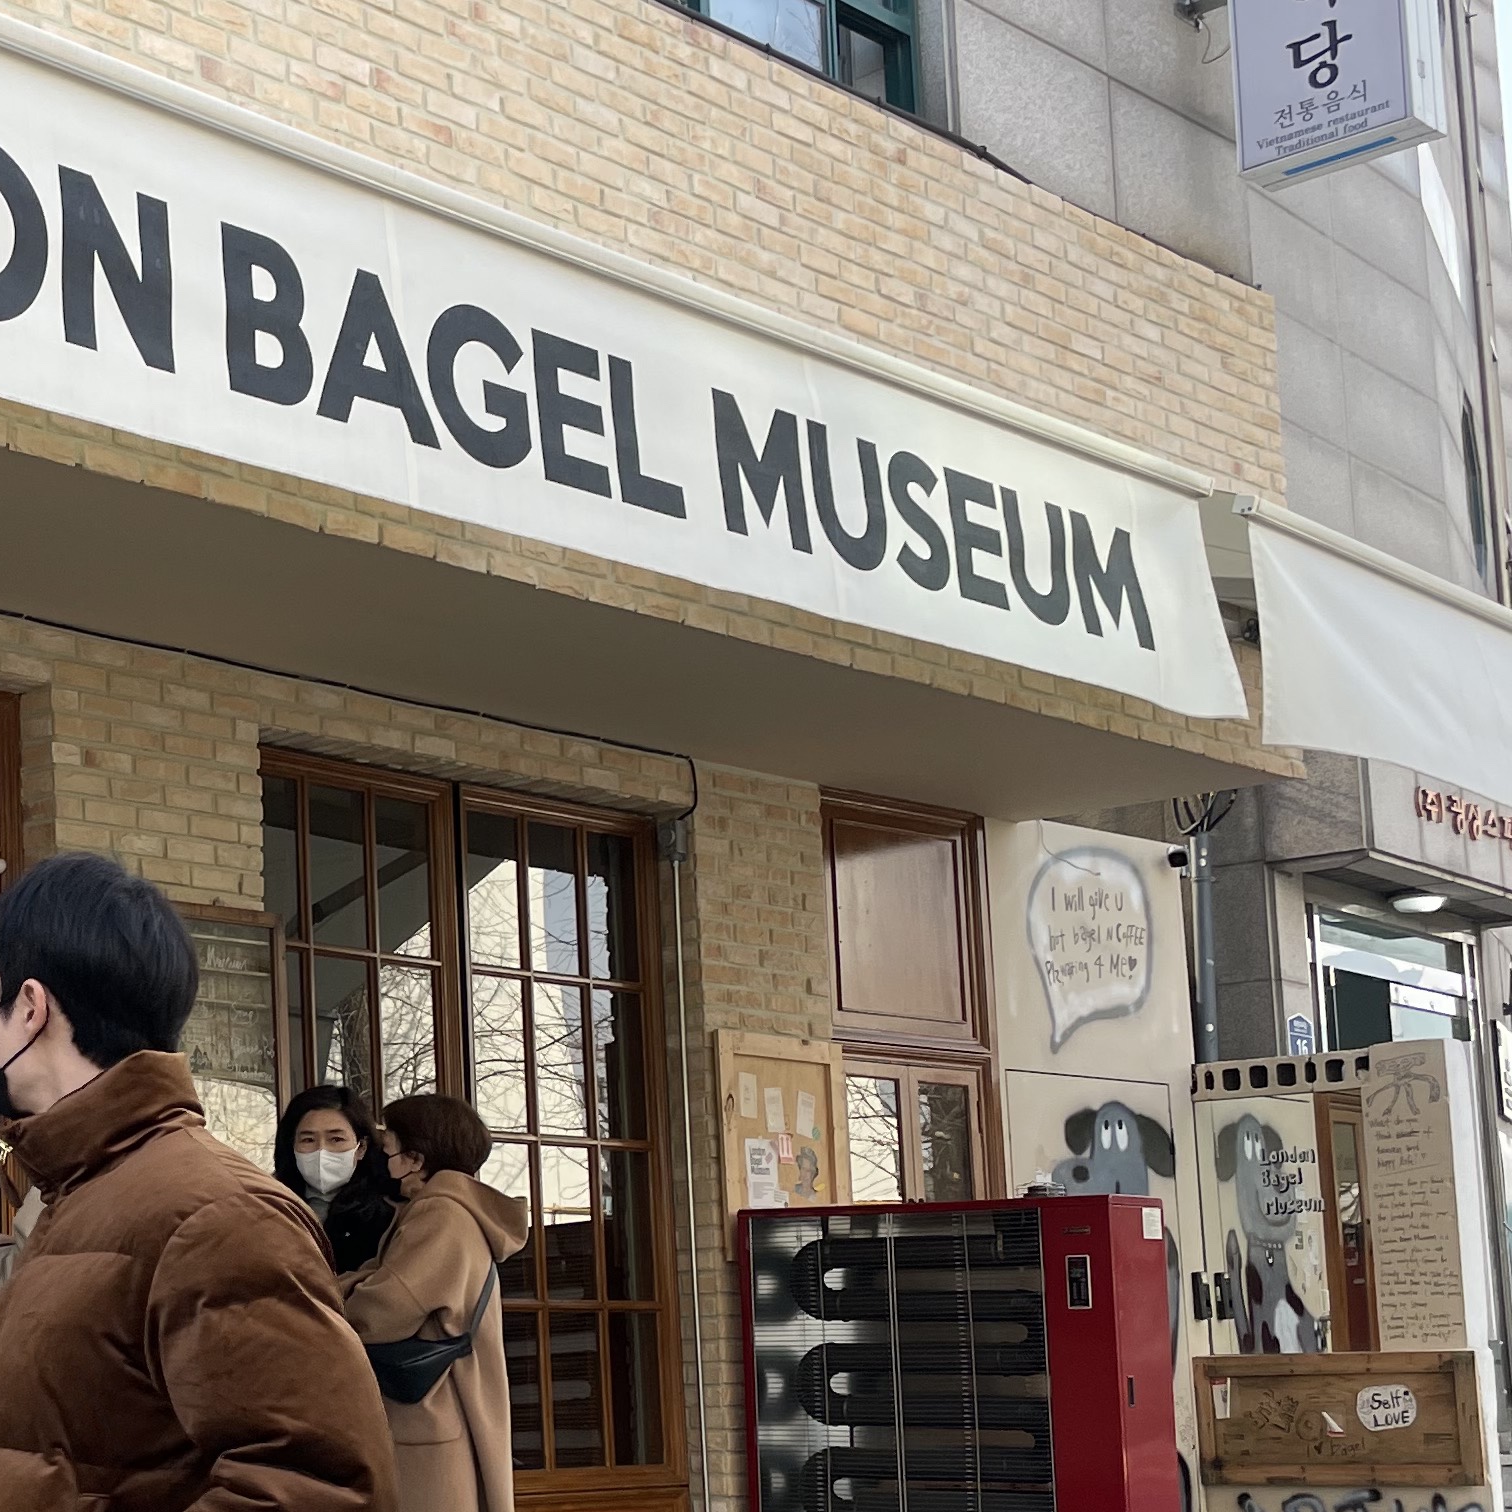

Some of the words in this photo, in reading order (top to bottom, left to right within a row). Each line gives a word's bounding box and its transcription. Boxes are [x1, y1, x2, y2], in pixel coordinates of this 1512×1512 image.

[1273, 79, 1368, 130] 전통음식
[1256, 120, 1324, 150] Vietnamese
[1327, 99, 1390, 128] restaurant
[1274, 127, 1340, 157] Traditional
[1342, 118, 1368, 135] food
[220, 222, 686, 520] BAGEL
[711, 387, 1156, 651] MUSEUM
[1051, 885, 1056, 912] I
[1093, 954, 1105, 979] 4
[1260, 1145, 1316, 1167] London
[1261, 1167, 1303, 1194] Bagel
[1369, 1391, 1403, 1412] Self
[1372, 1410, 1411, 1428] LOVE
